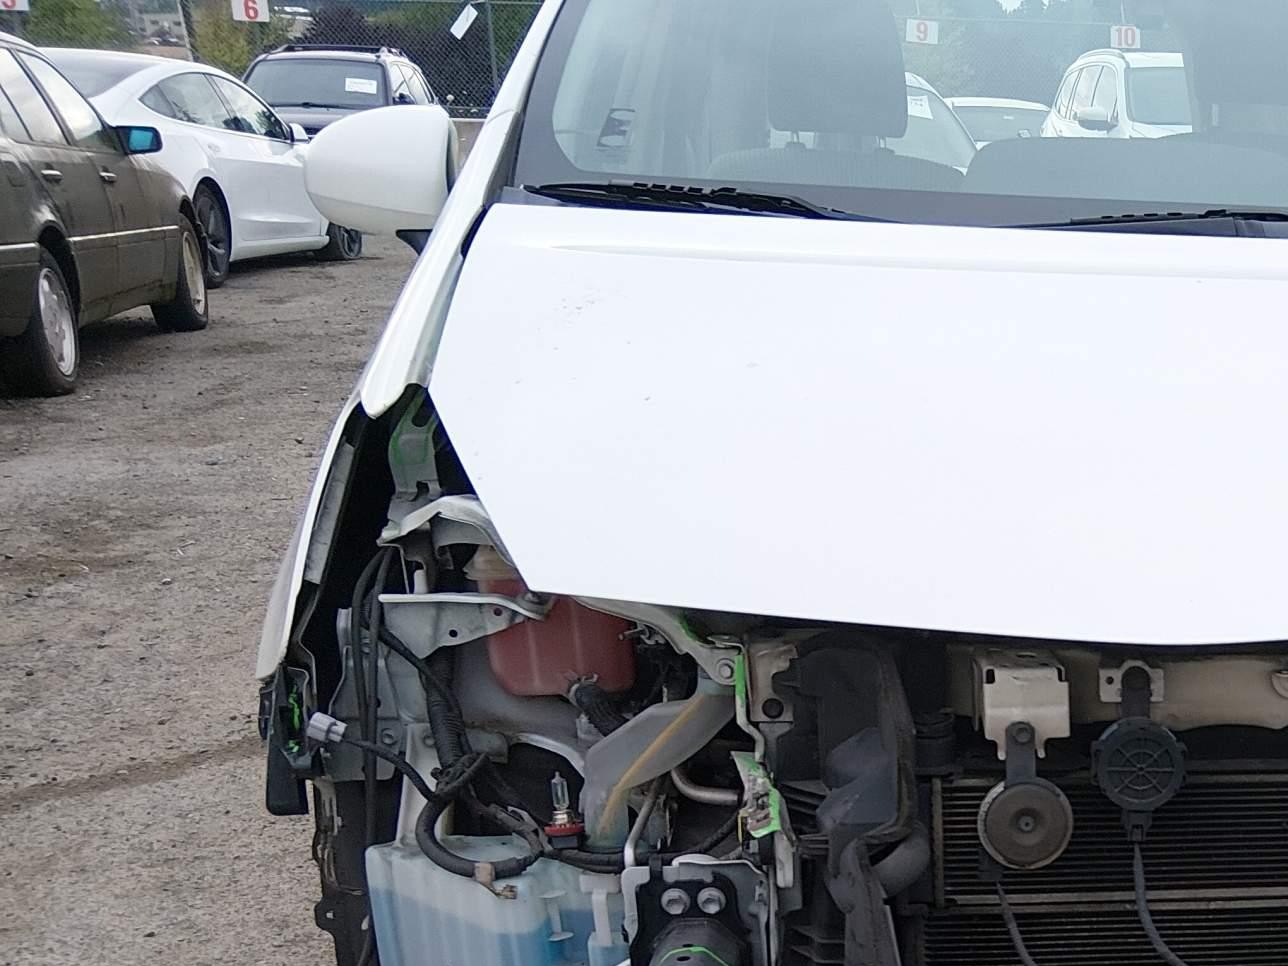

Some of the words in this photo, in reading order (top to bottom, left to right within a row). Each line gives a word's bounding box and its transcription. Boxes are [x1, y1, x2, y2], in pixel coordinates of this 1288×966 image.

[243, 0, 258, 20] 6
[916, 21, 929, 41] 9
[1116, 27, 1136, 48] 10
